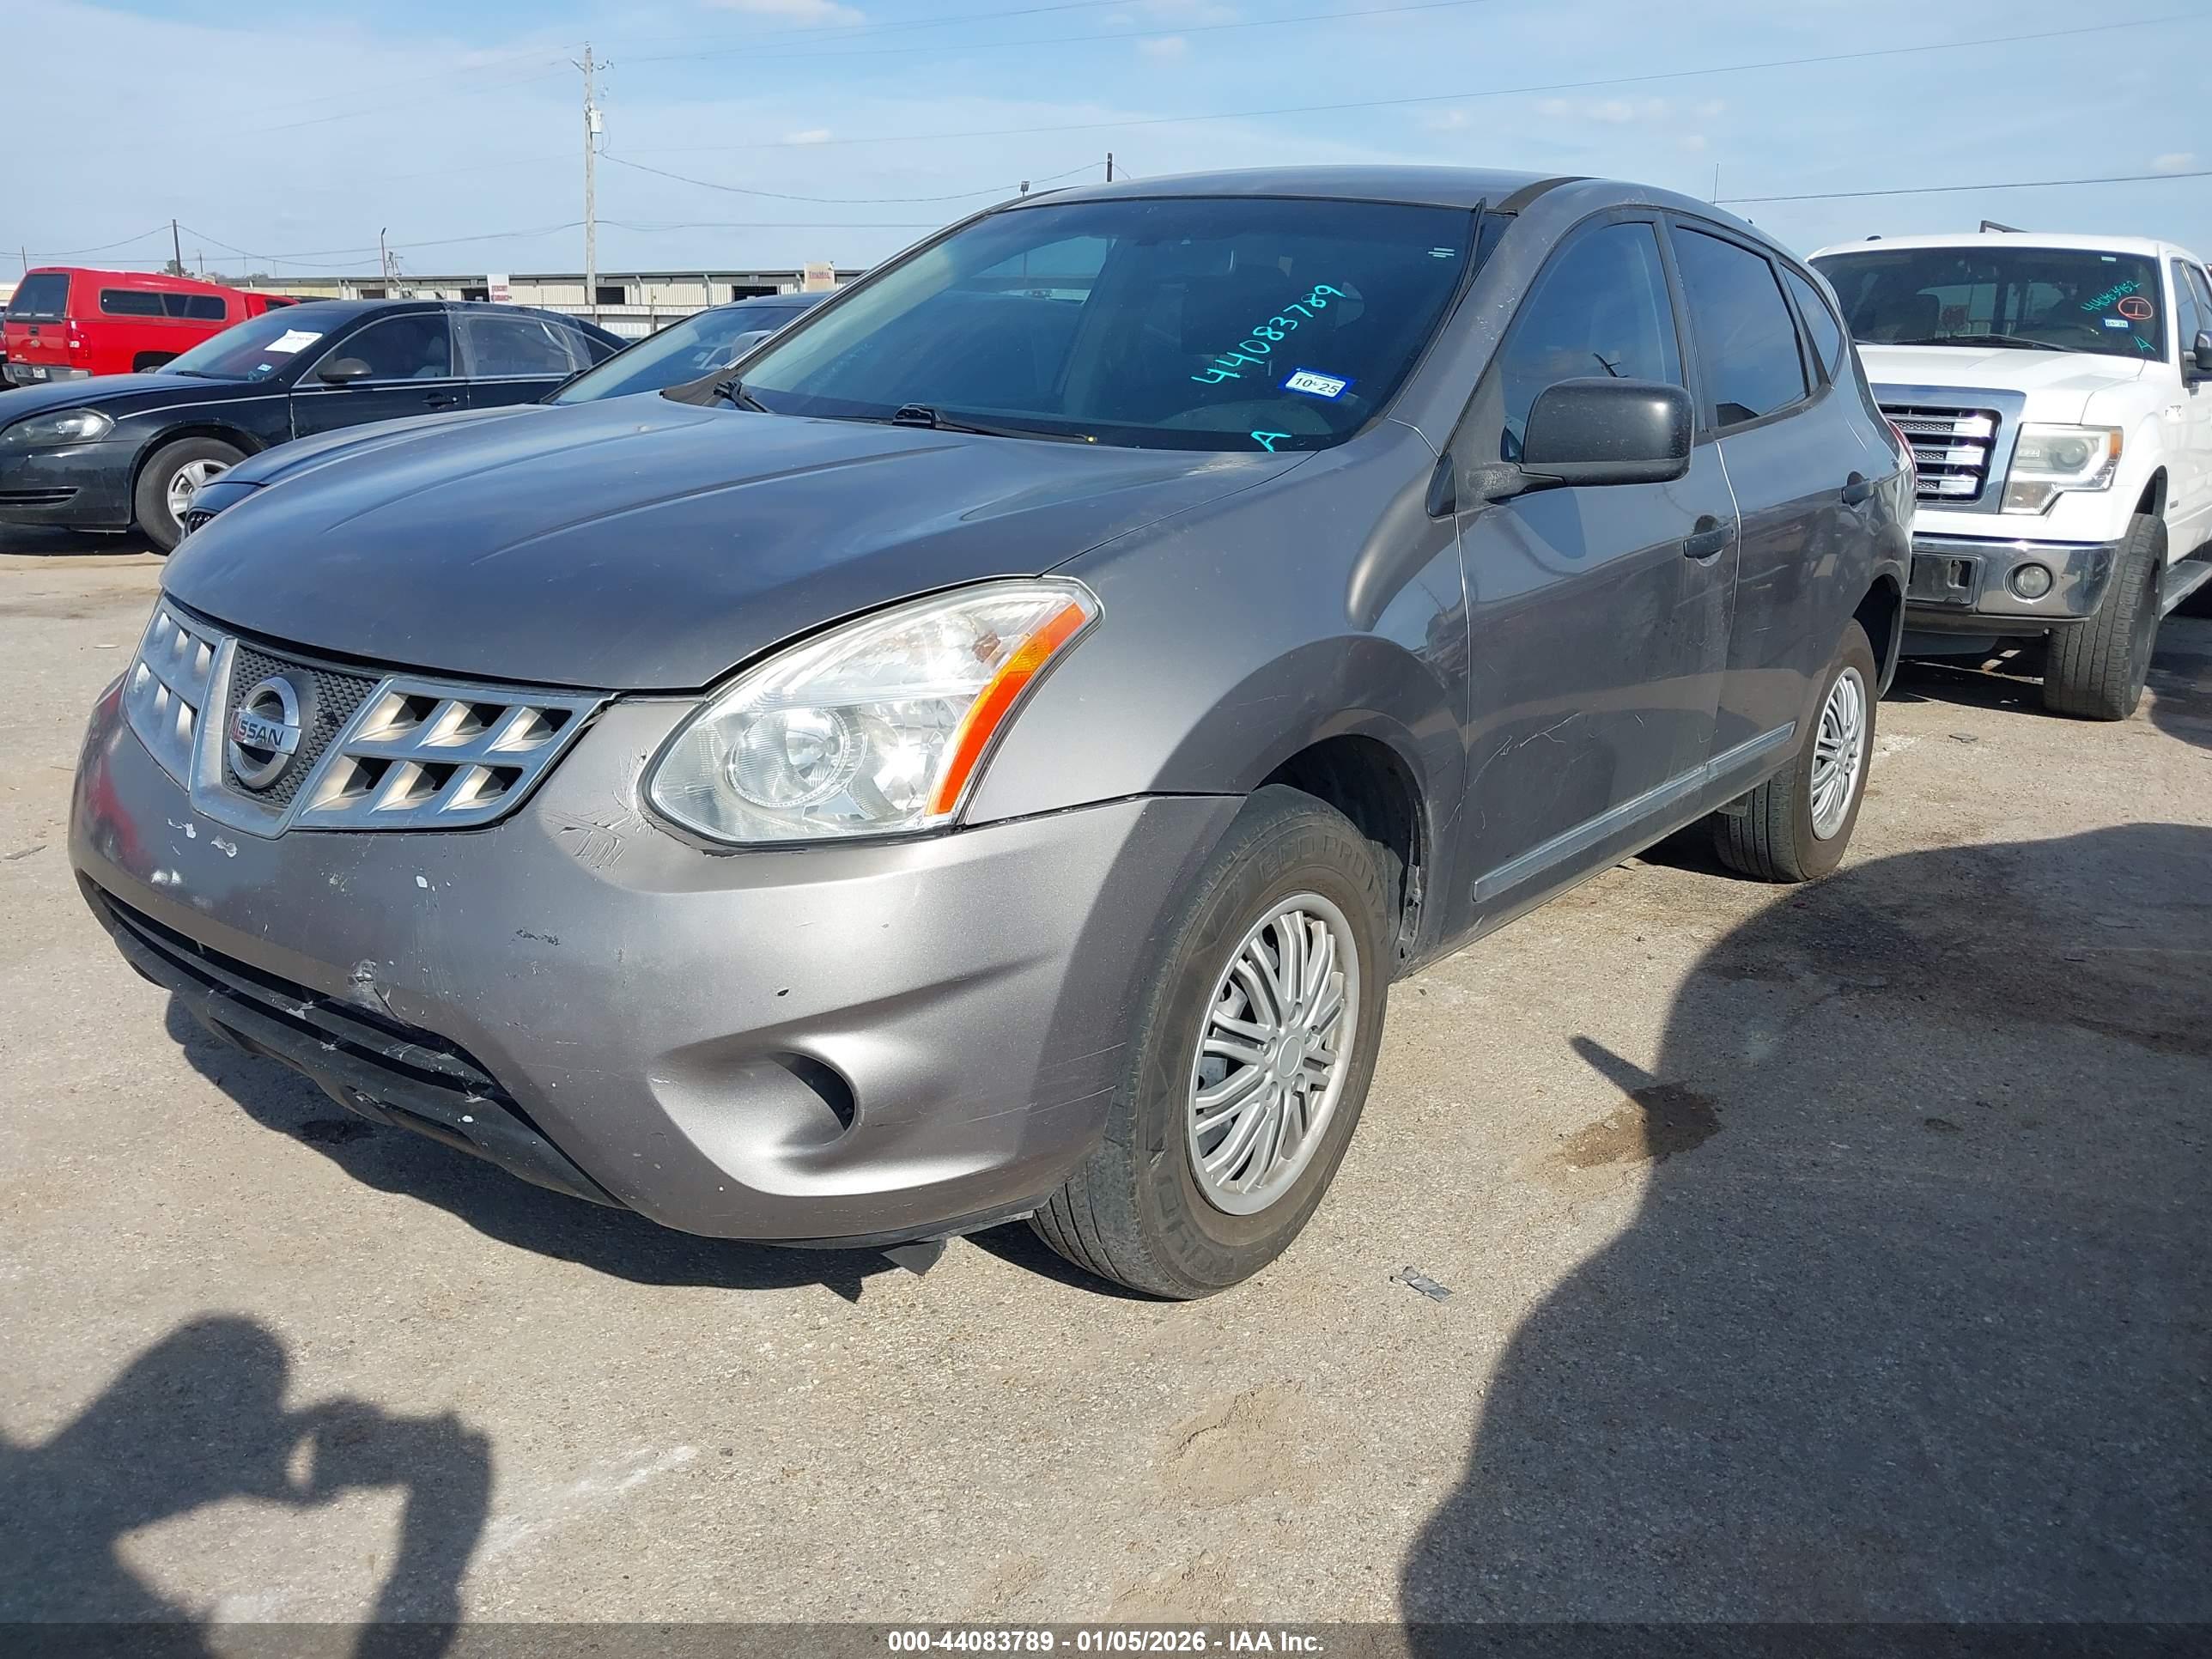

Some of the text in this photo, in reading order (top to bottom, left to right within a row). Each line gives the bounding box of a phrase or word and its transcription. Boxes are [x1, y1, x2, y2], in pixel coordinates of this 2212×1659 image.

[1191, 284, 1346, 384] 44083789
[2133, 336, 2156, 353] A
[1250, 430, 1291, 453] A
